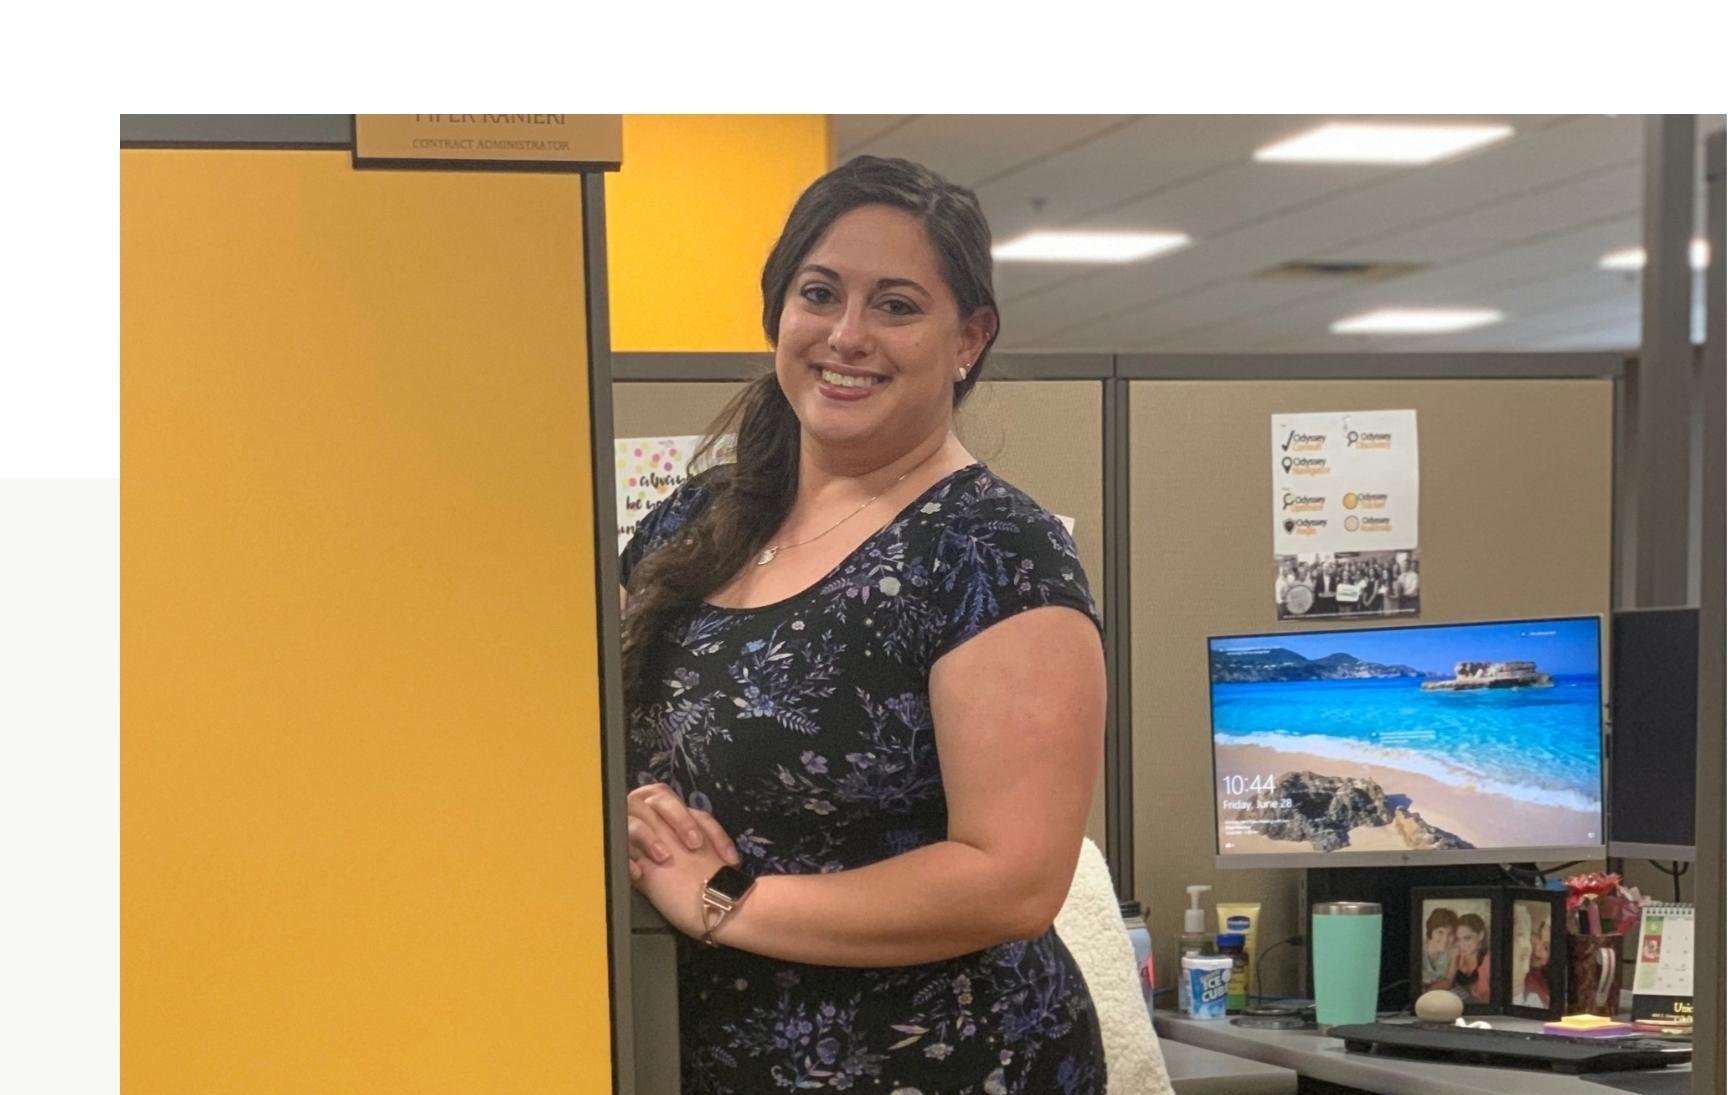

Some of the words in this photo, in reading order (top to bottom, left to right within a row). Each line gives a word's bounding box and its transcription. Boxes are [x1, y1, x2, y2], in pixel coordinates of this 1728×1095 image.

[412, 138, 474, 149] CONTRACT
[477, 139, 569, 151] ADMINISTRATOR
[1223, 774, 1276, 795] 10:44
[1223, 799, 1253, 811] Friday,
[1256, 799, 1279, 809] June
[1280, 797, 1293, 808] 28
[1200, 975, 1223, 991] ICE
